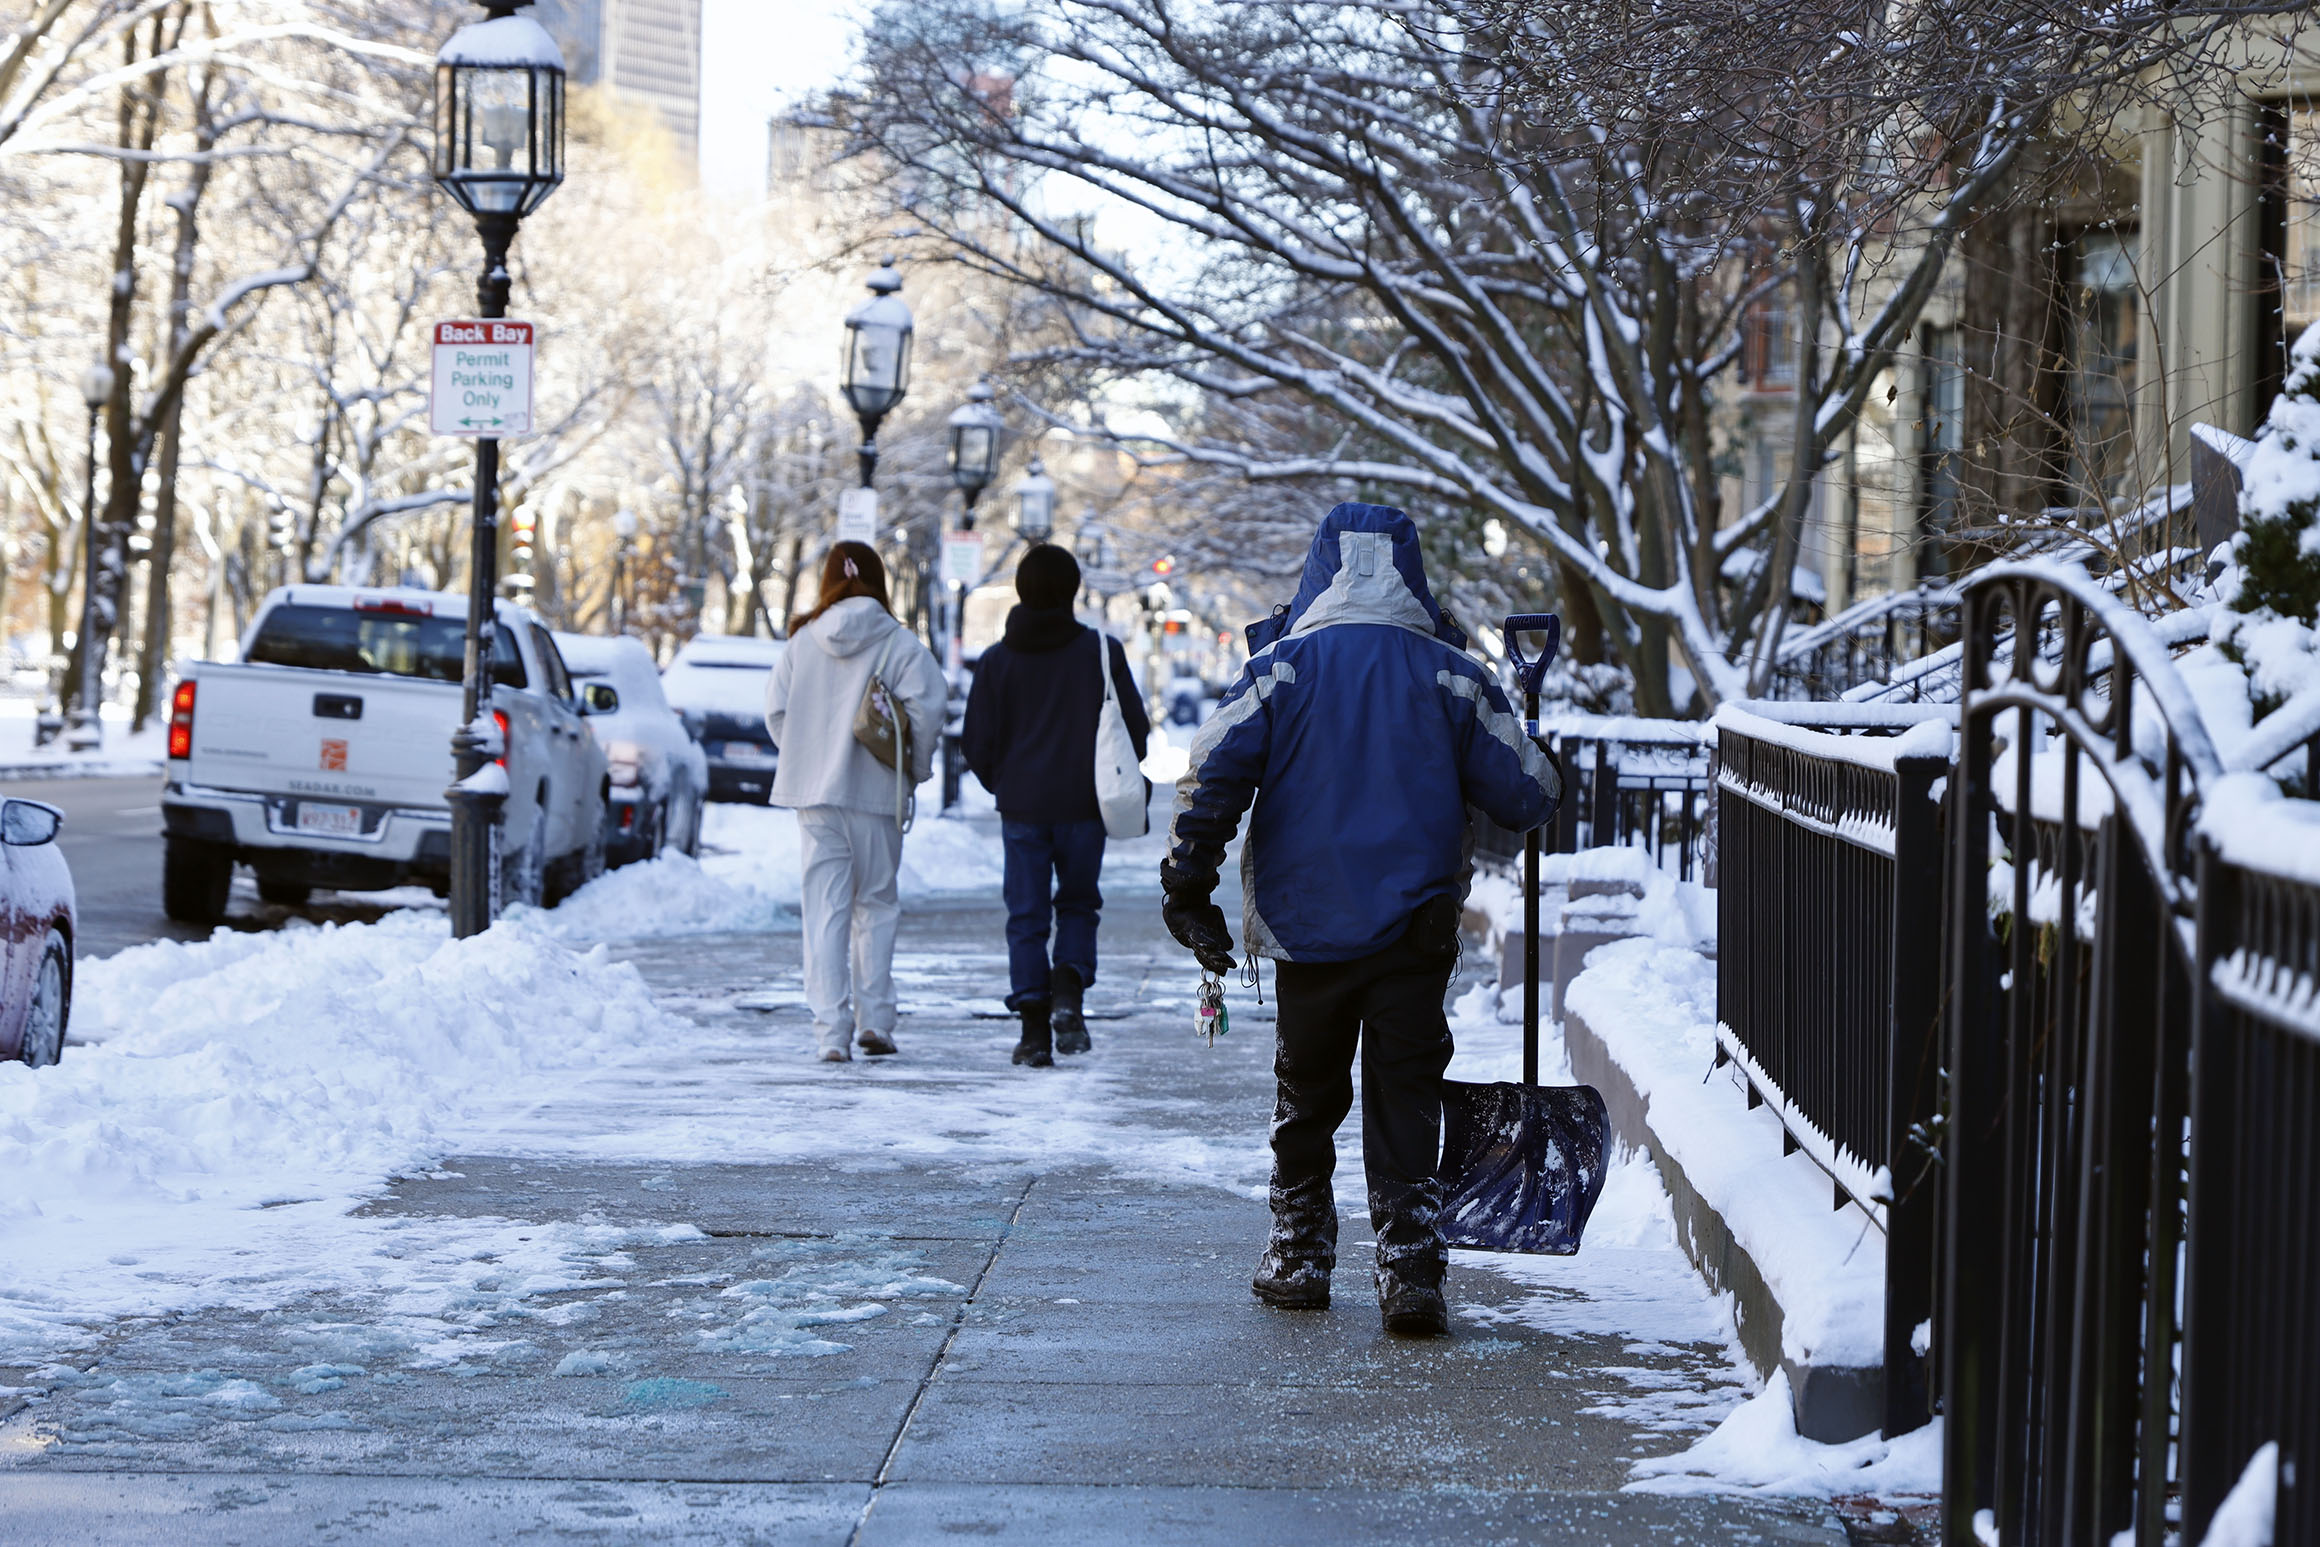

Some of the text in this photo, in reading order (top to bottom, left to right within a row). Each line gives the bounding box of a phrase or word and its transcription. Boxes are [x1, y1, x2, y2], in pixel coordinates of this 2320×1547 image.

[441, 324, 528, 345] Back Bay
[456, 351, 510, 367] Permit
[451, 371, 513, 390] Parking
[463, 390, 500, 409] Only
